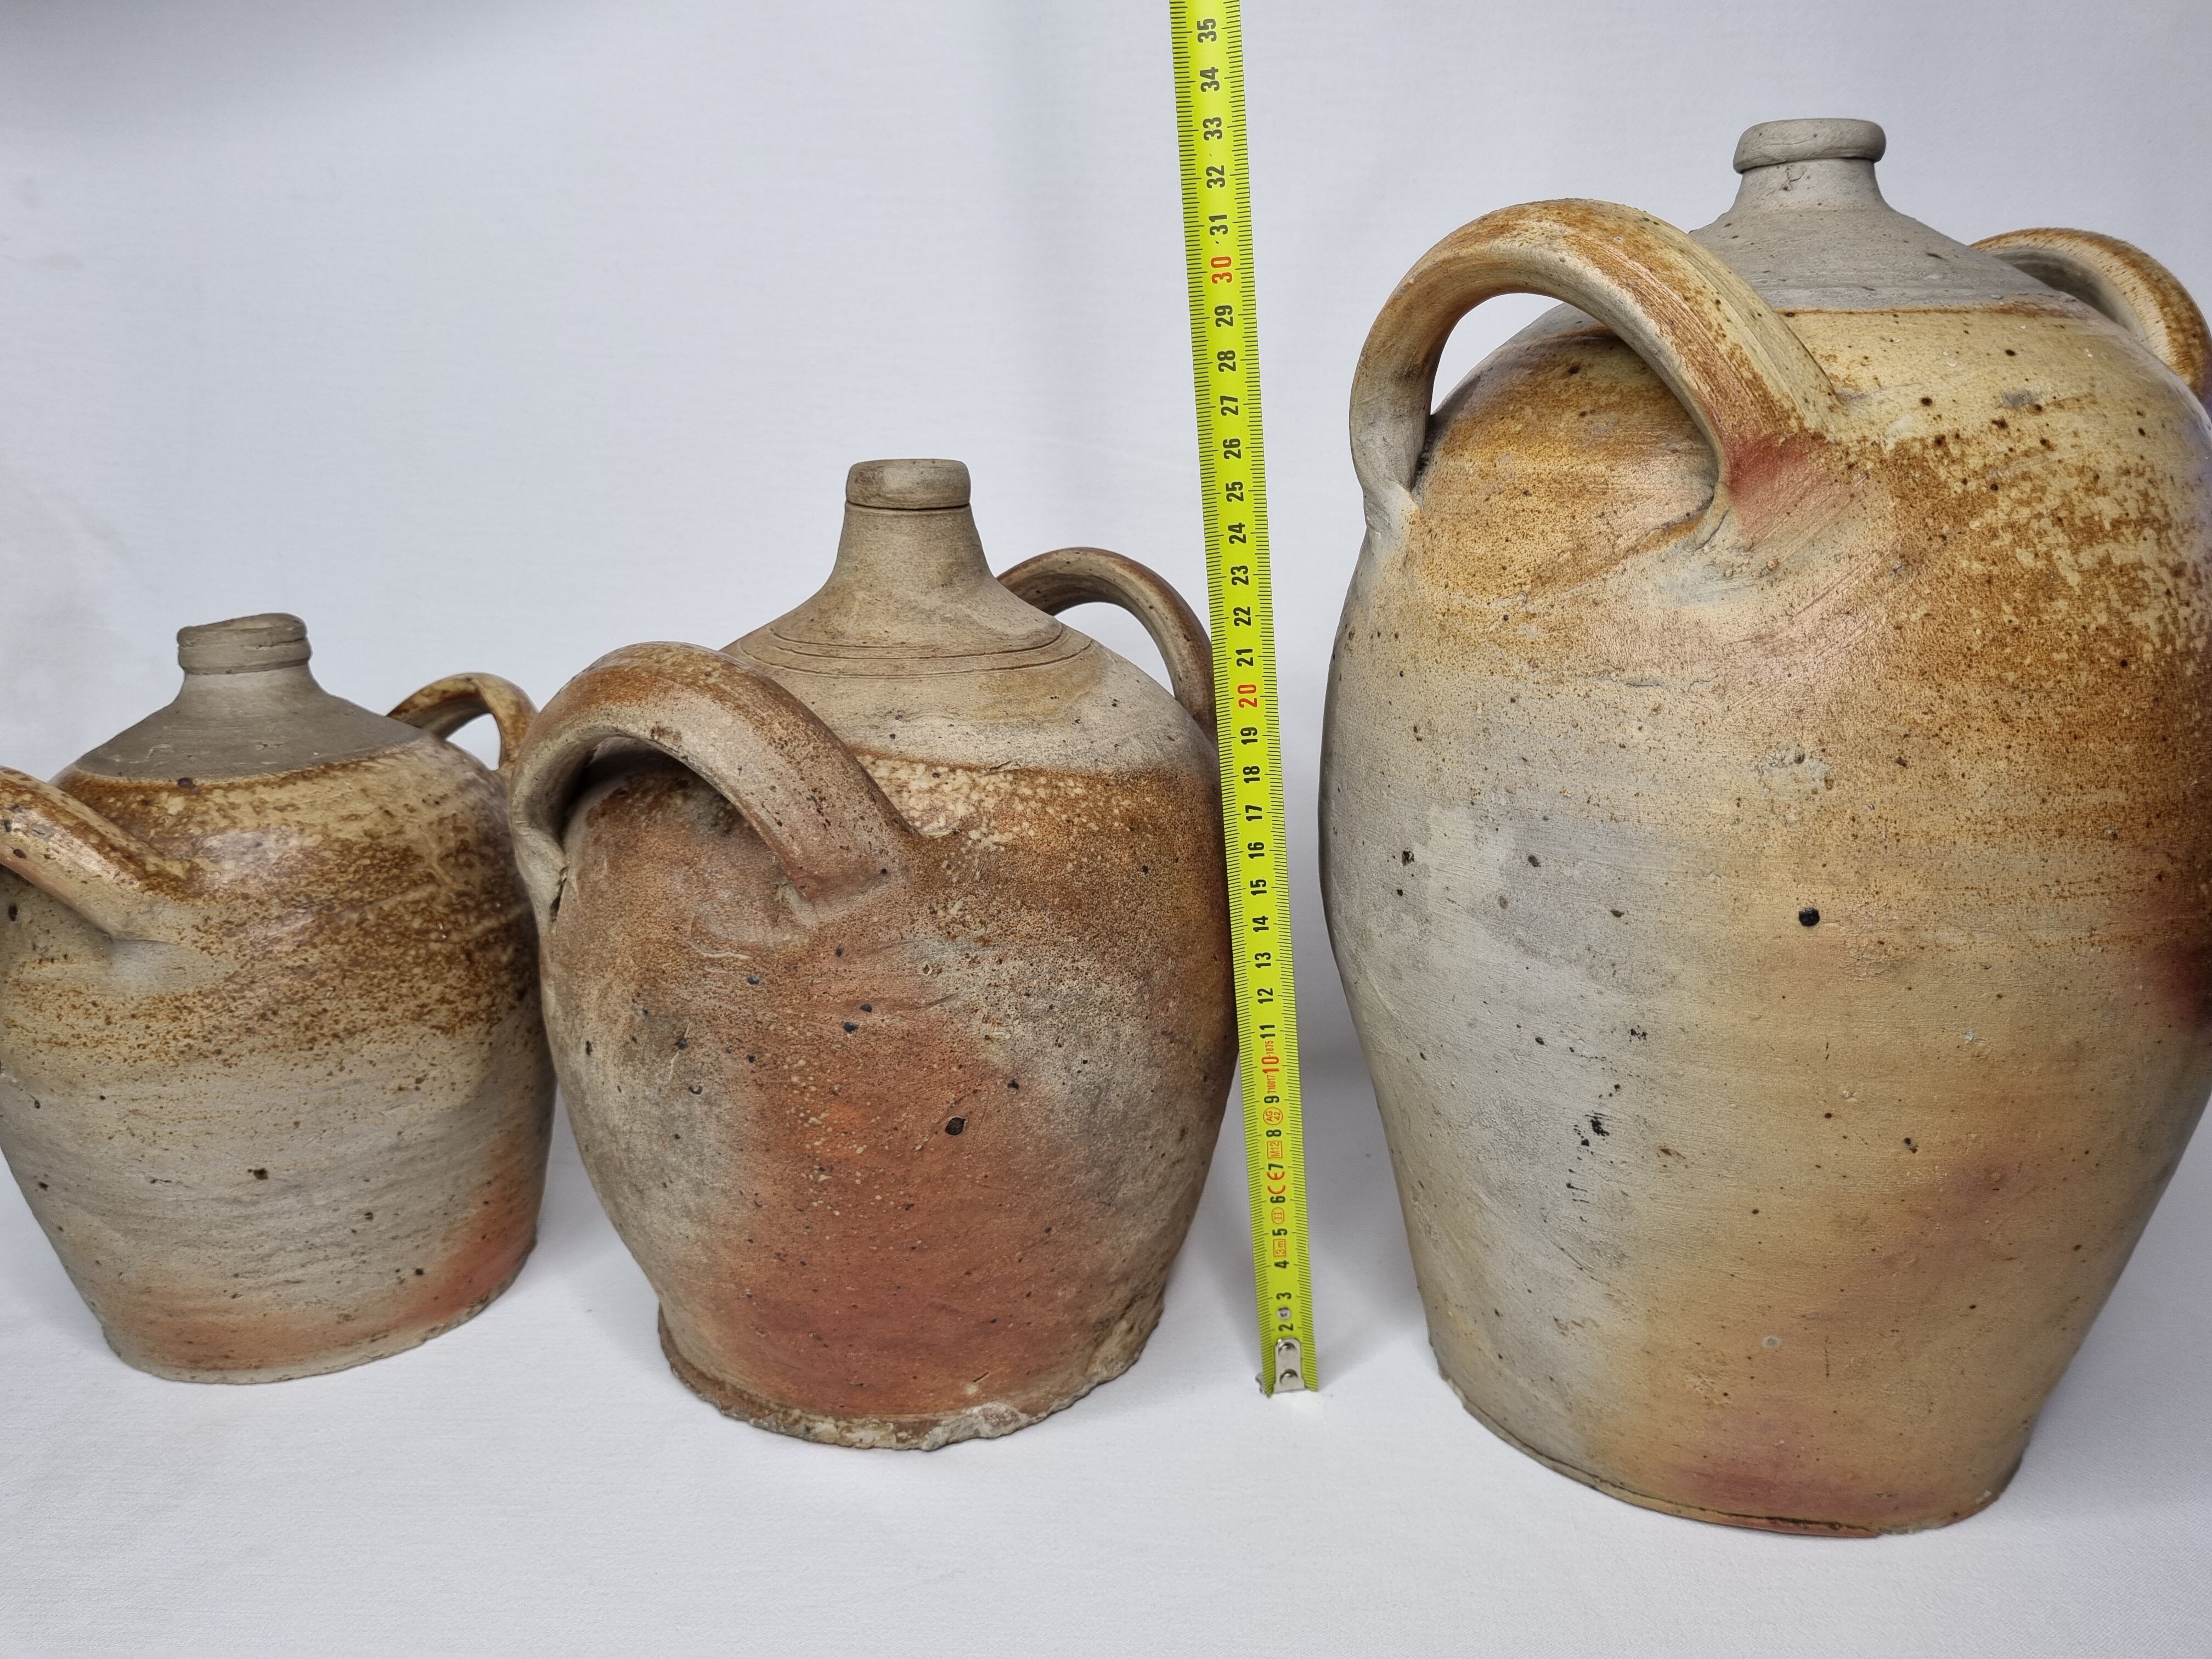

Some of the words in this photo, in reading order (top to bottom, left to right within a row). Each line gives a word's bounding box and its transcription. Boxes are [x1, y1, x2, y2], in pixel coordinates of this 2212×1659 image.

[1197, 18, 1216, 43] 35
[1200, 67, 1220, 92] 34
[1203, 117, 1222, 140] 33
[1206, 165, 1225, 188] 32
[1209, 215, 1228, 235] 31
[1211, 256, 1232, 284] 30
[1215, 305, 1233, 328] 29
[1217, 350, 1236, 373] 28
[1220, 396, 1239, 416] 27
[1223, 438, 1241, 459] 26
[1226, 481, 1244, 502] 25
[1228, 522, 1246, 544] 24
[1231, 565, 1249, 585] 23
[1233, 606, 1251, 626] 22
[1236, 648, 1254, 667] 21
[1238, 684, 1257, 708] 20
[1240, 727, 1258, 745] 19
[1243, 766, 1260, 783] 18
[1245, 805, 1262, 821] 17
[1248, 842, 1265, 859] 16
[1250, 879, 1267, 896] 15
[1252, 916, 1269, 932] 14
[1255, 952, 1271, 968] 13
[1257, 988, 1273, 1004] 12
[1260, 1024, 1275, 1039] 11
[1262, 1056, 1279, 1074] 10
[1264, 1095, 1279, 1103] 9
[1266, 1110, 1273, 1122] AG
[1266, 1129, 1282, 1137] 8
[1270, 1141, 1280, 1156] M12
[1274, 1260, 1289, 1268] 4
